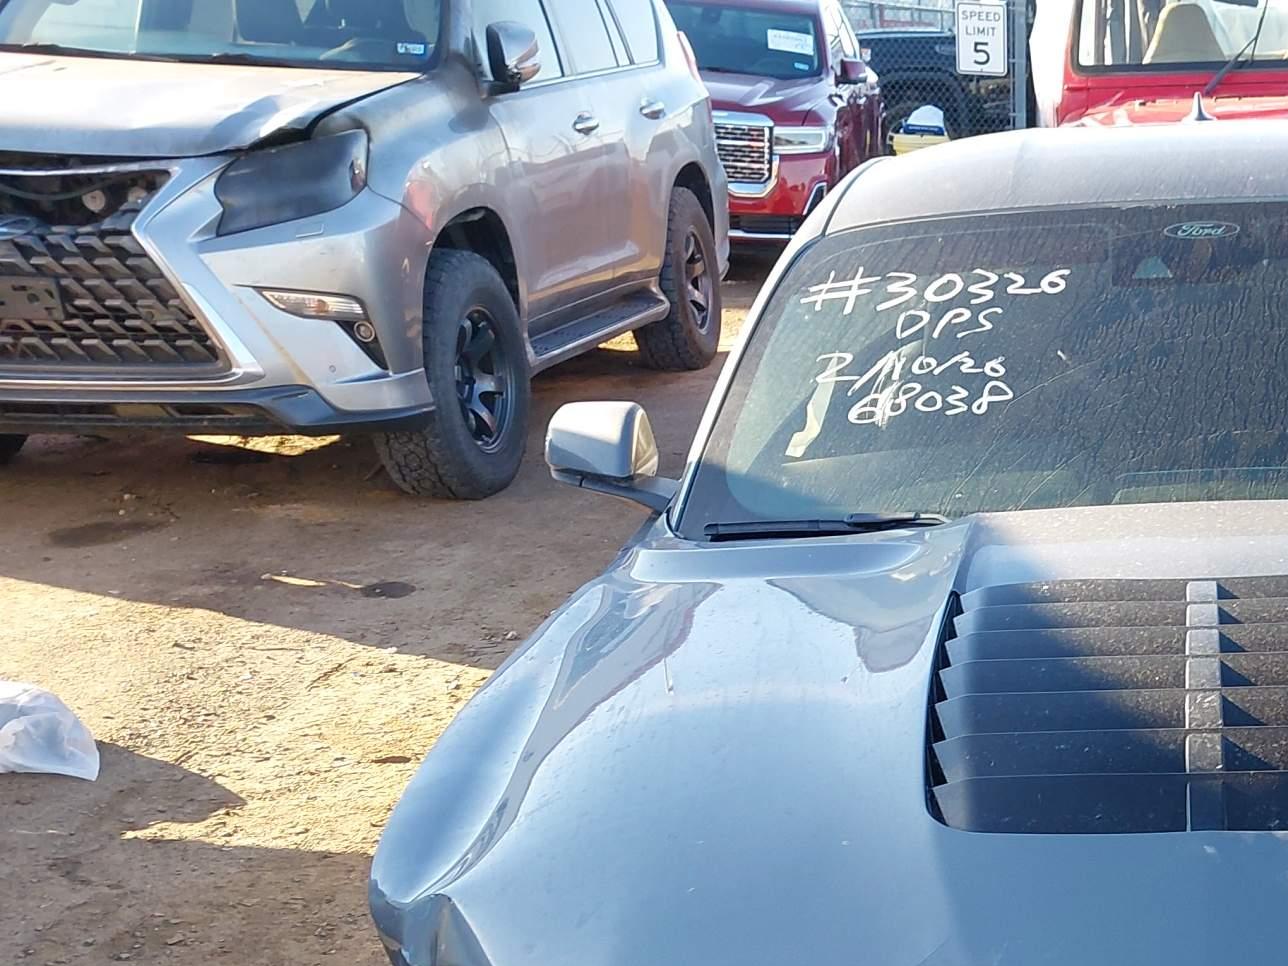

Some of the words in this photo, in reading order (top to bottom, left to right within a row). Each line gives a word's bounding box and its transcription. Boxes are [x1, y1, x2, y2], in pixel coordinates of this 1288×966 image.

[961, 9, 1001, 22] SPEED
[965, 25, 996, 37] LIMIT
[973, 41, 991, 66] 5
[800, 266, 1071, 315] #30326
[896, 307, 1004, 340] DPS
